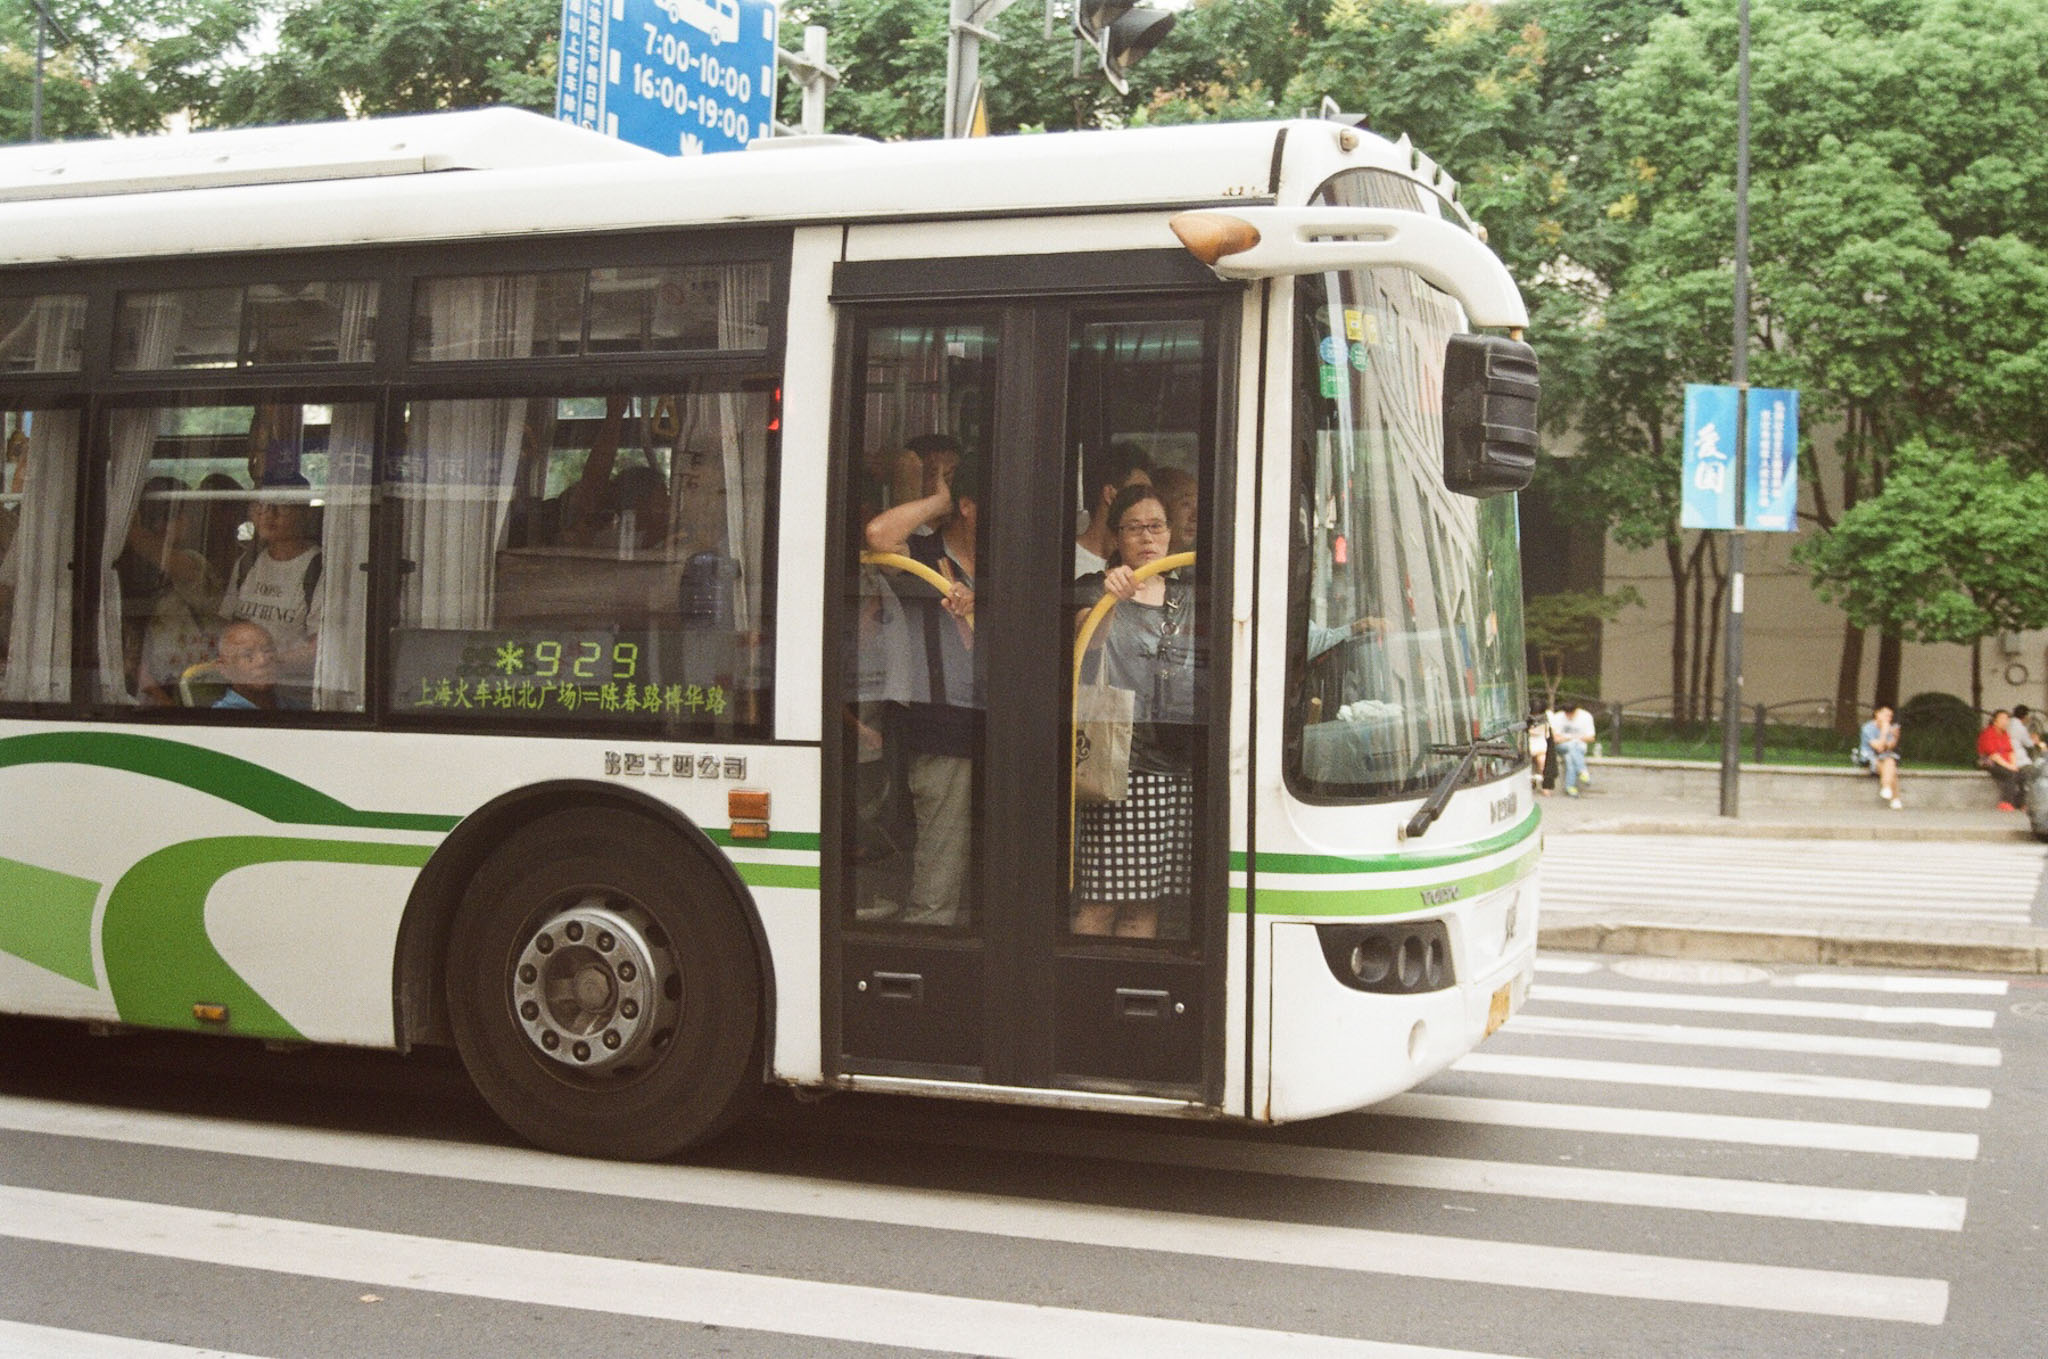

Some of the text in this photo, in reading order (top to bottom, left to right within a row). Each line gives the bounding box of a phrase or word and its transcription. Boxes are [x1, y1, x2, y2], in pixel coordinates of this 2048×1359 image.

[633, 63, 749, 144] 16:00-19:00
[642, 22, 751, 104] 7:00-10:00
[535, 640, 640, 680] 929
